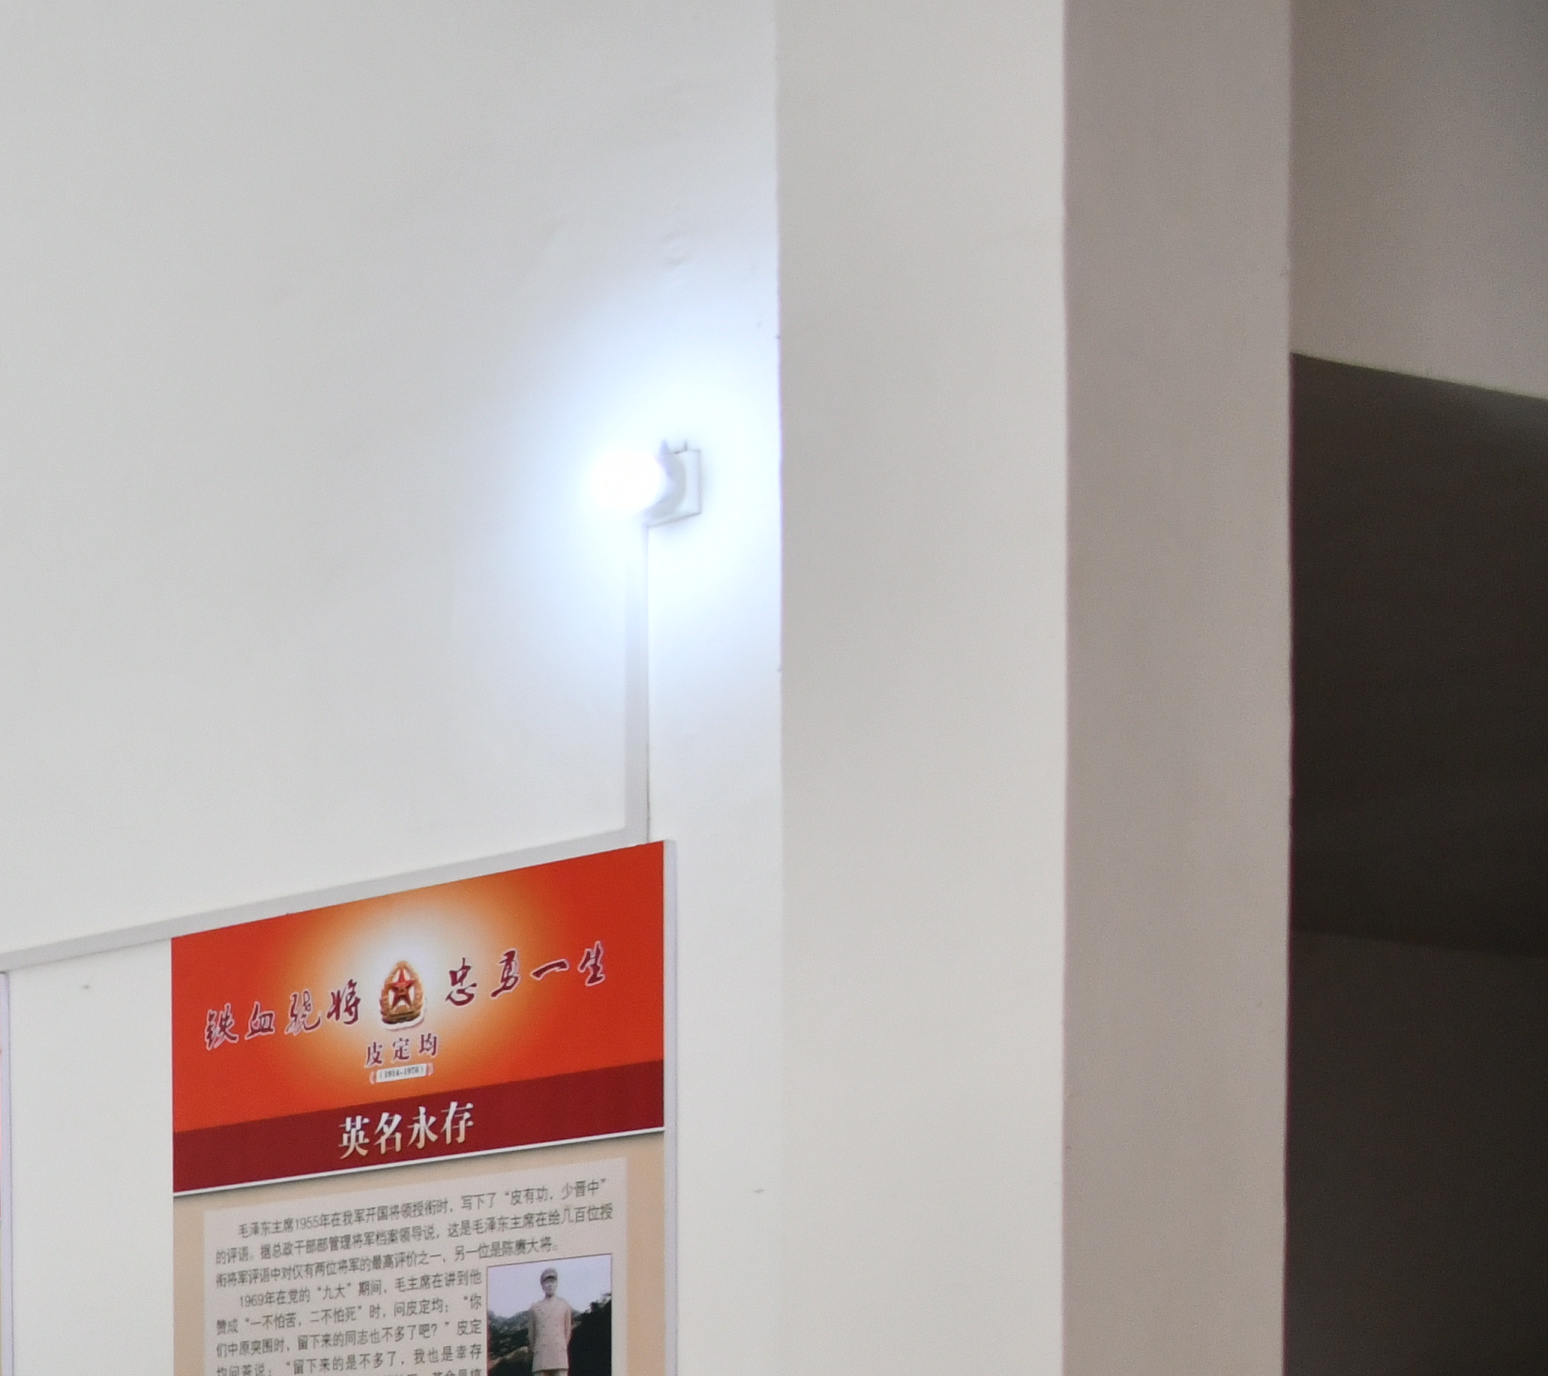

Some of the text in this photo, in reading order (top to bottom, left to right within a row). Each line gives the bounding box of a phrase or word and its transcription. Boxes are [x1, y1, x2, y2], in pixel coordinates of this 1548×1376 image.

[204, 930, 606, 1051] 铁血骁将 忠勇一生
[364, 1030, 439, 1069] 皮定均
[338, 1097, 474, 1161] 英名永存
